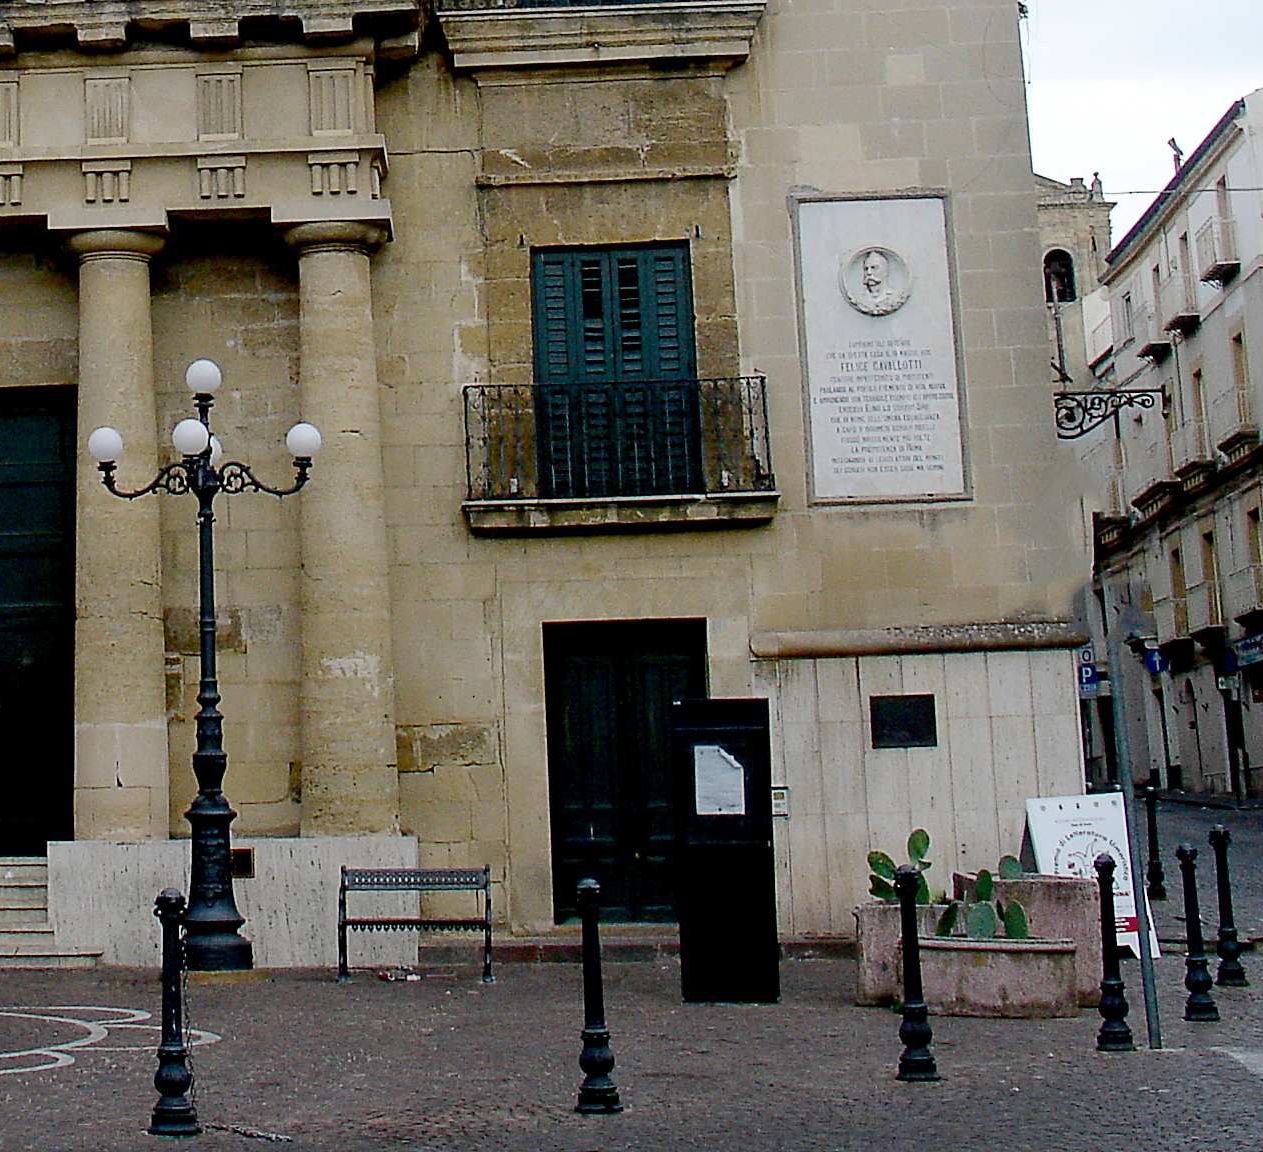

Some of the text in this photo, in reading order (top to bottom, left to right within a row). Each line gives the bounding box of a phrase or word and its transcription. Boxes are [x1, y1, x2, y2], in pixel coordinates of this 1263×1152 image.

[841, 360, 922, 372] FELICE CAVALLOTTI
[1082, 667, 1092, 683] P
